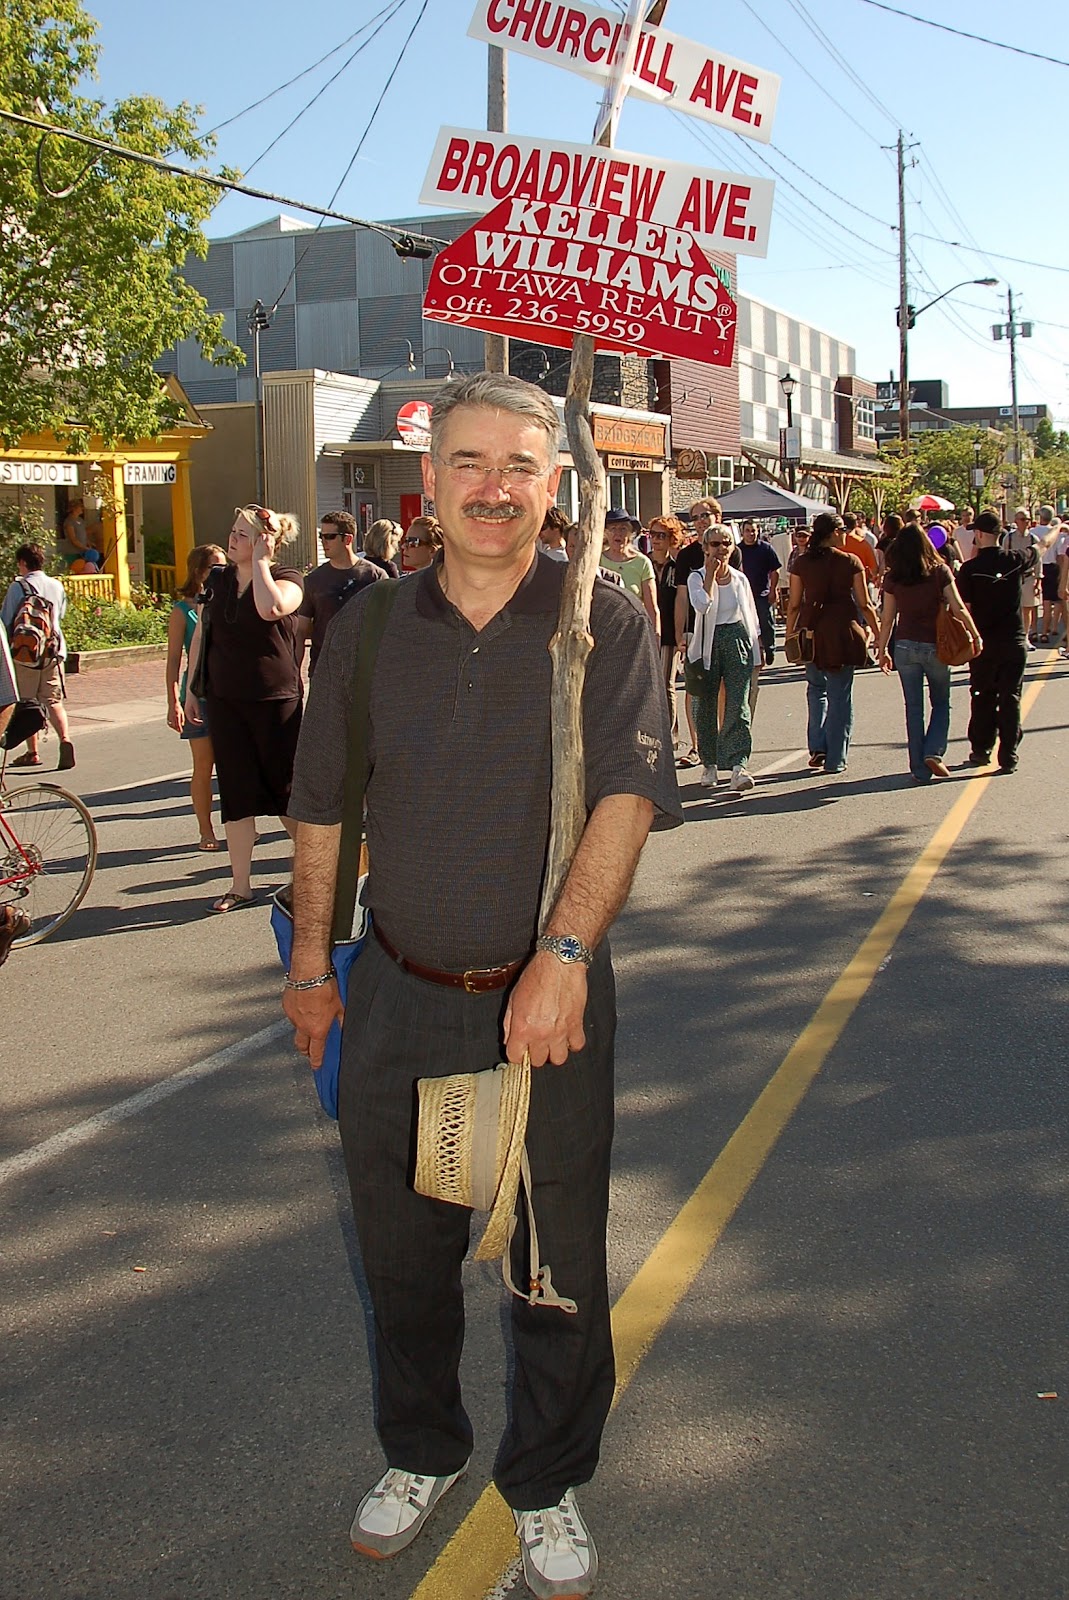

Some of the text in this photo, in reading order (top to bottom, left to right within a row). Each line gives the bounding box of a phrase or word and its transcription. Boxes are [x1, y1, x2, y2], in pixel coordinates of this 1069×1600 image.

[689, 59, 762, 128] AVE.
[436, 138, 757, 242] BROADVIEW AVE.
[505, 197, 695, 269] KELLER
[438, 264, 736, 341] OTTAWA REALTY
[474, 230, 719, 312] WILLIAMS
[446, 294, 493, 315] Off:
[503, 298, 646, 343] 236-5959
[596, 424, 663, 449] BRIDGEHEAD
[3, 463, 73, 482] STUDIO II
[127, 465, 176, 482] FRAMING
